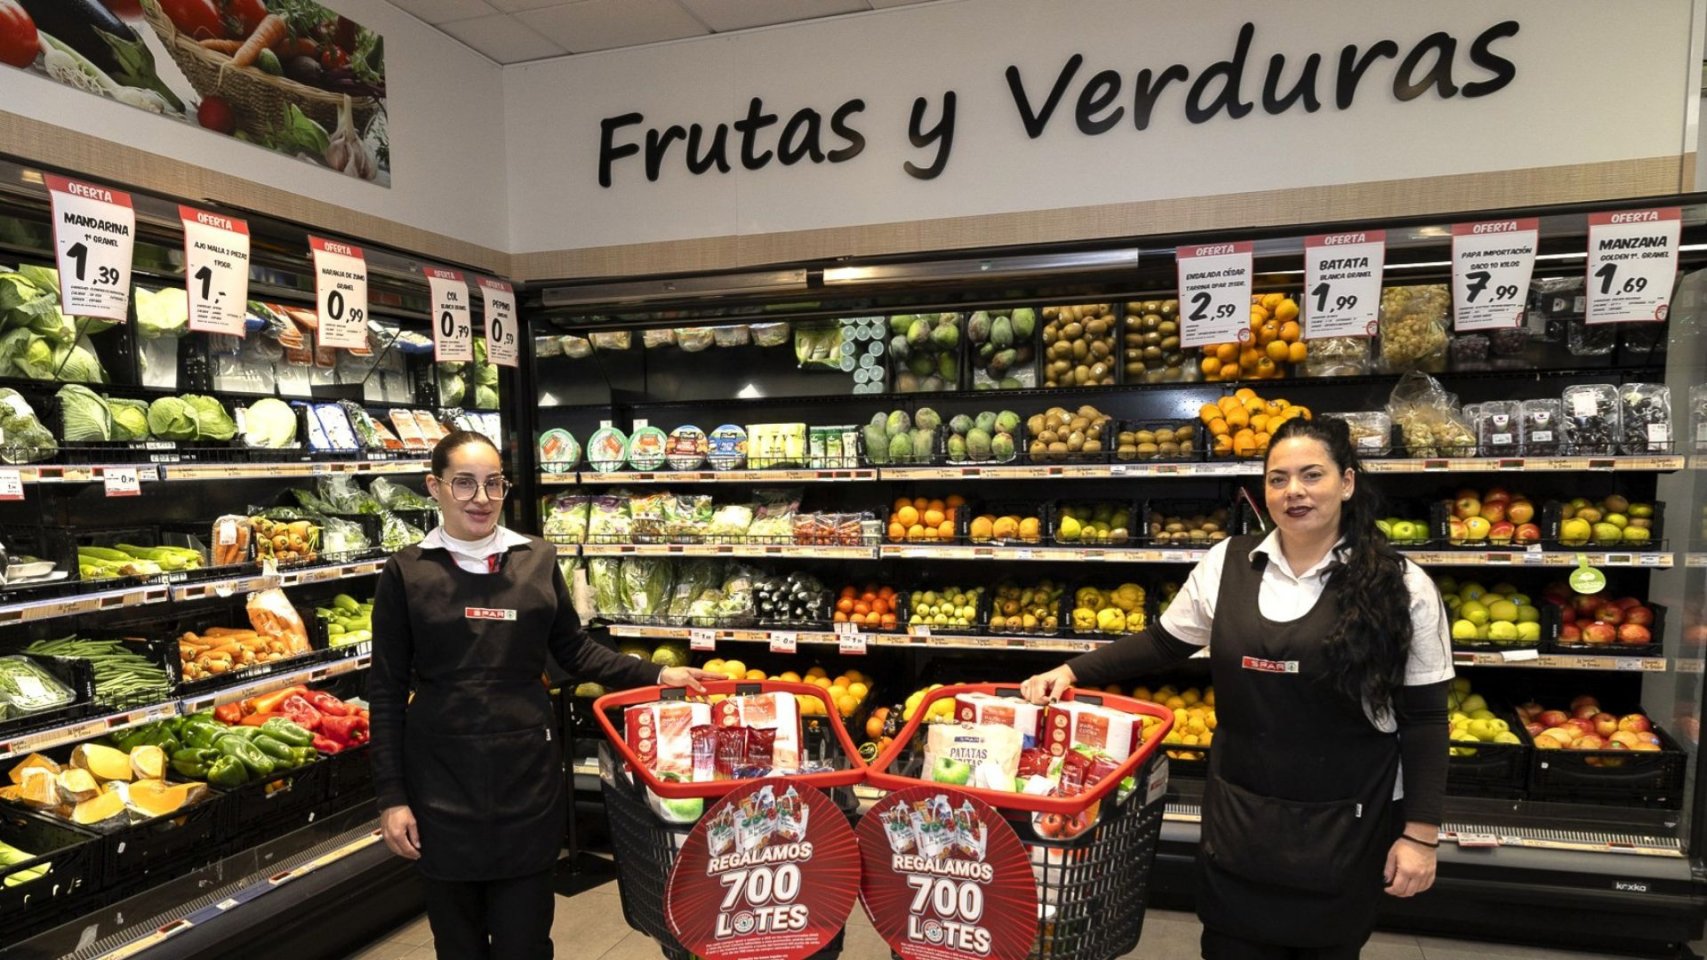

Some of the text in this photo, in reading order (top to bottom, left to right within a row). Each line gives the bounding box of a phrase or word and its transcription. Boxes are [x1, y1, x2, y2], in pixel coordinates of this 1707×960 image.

[598, 21, 1520, 188] Frutas y Verduras
[69, 182, 113, 203] OFERTA
[64, 212, 129, 236] MANDARINA
[197, 212, 233, 231] OFERTA
[1610, 211, 1659, 224] OFERTA
[1472, 221, 1518, 234] OFERTA
[93, 235, 119, 247] GRANEL
[1324, 233, 1366, 245] OFERTA
[1598, 236, 1668, 251] MANZANA
[194, 241, 206, 250] AJO
[207, 244, 225, 254] MALLA
[230, 250, 248, 260] PIEZAS
[324, 241, 352, 256] OFERTA
[1195, 245, 1235, 257] OFERTA
[1461, 245, 1533, 259] PAPA IMPORTACIÓN
[1600, 253, 1630, 261] GOLDEN
[1641, 251, 1670, 259] GRANEL
[1319, 257, 1369, 271] BATATA
[1470, 262, 1489, 270] SACO
[1499, 260, 1521, 268] KILOS
[322, 267, 366, 282] NARANJA DE ZUMO
[433, 269, 456, 280] OFERTA
[1186, 267, 1246, 281] ENSALADA CÉSAR
[1320, 271, 1372, 281] BLANCA GRANEL
[336, 282, 354, 291] GRANEL
[1186, 283, 1211, 292] TARRINA
[446, 291, 458, 301] COL
[492, 299, 511, 312] PEPINO
[474, 610, 504, 618] SPAR
[1251, 660, 1286, 671] SPAR
[950, 747, 988, 760] PATATAS
[706, 842, 813, 875] REGALAMOS
[893, 854, 993, 881] REGALAMOS
[720, 863, 801, 911] 700
[908, 876, 984, 921] 700
[716, 904, 808, 938] LOTES
[909, 915, 991, 954] LOTES
